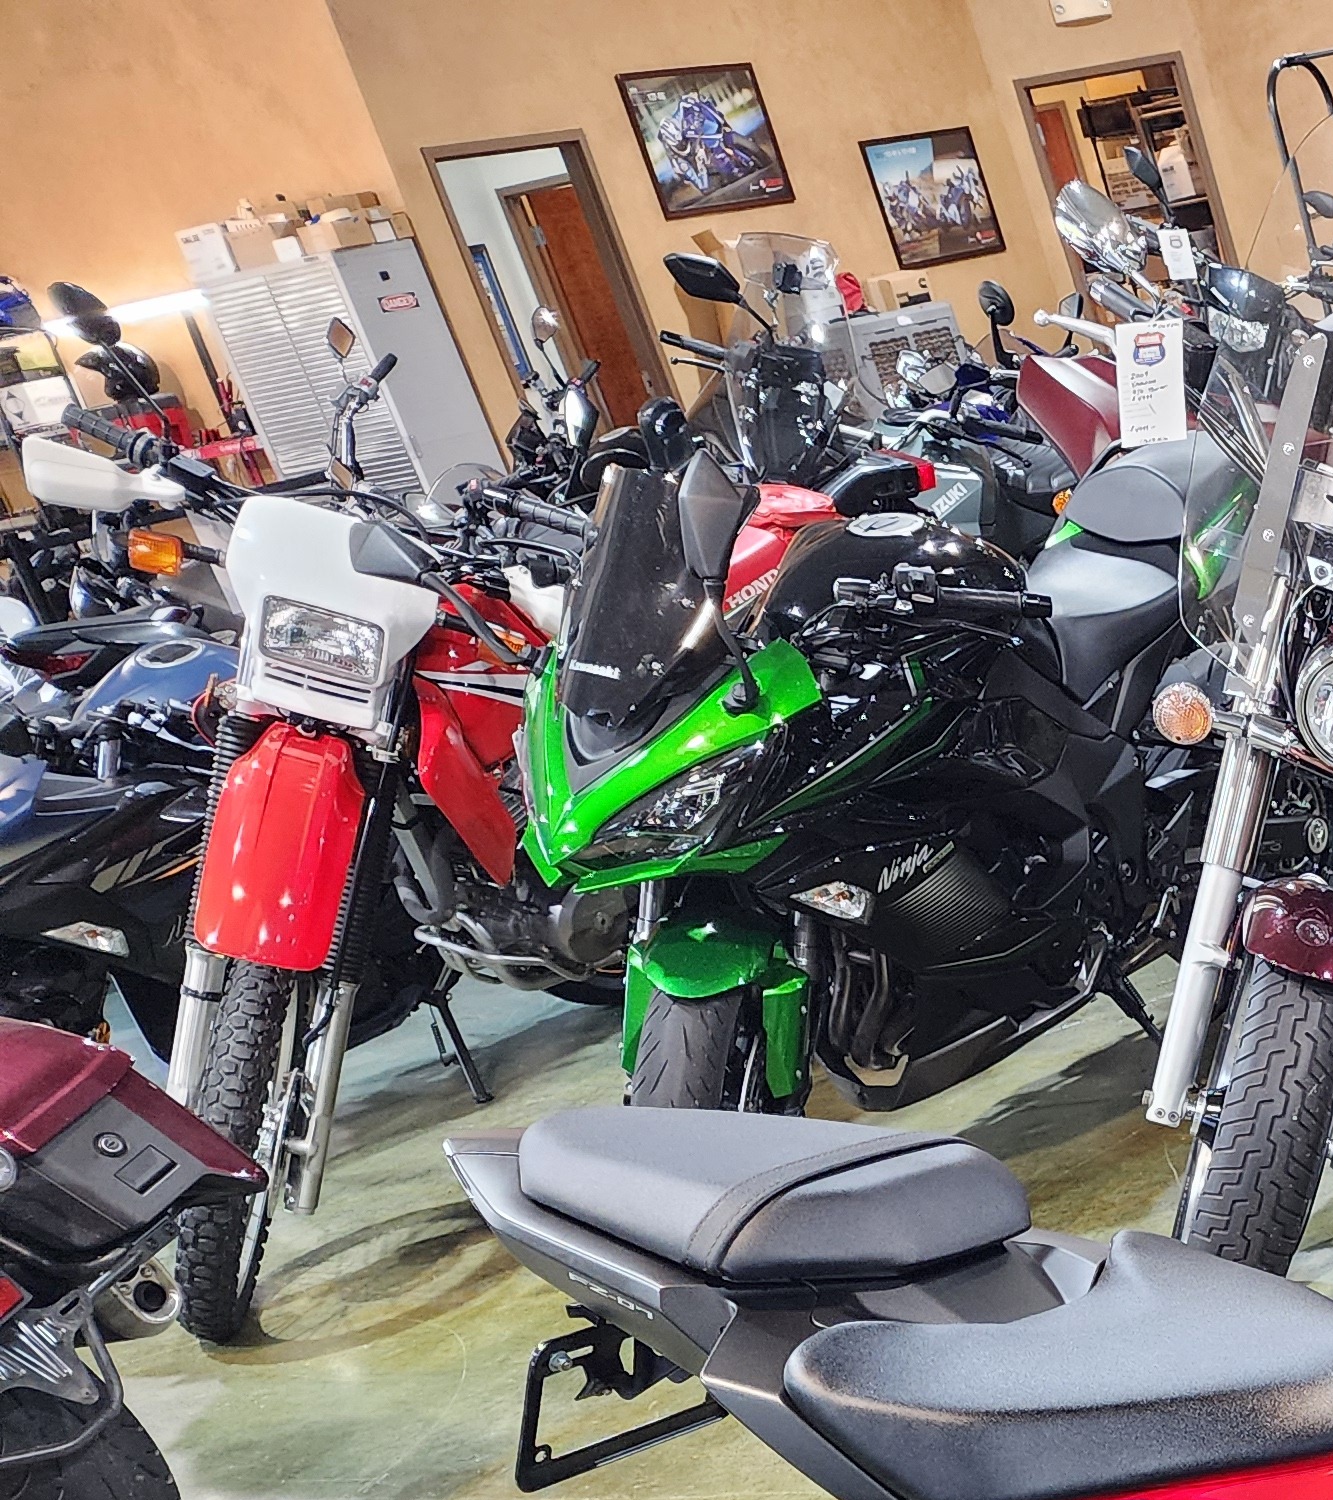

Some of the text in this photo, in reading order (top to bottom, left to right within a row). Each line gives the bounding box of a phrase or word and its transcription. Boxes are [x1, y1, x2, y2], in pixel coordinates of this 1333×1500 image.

[932, 481, 968, 520] ZUKI
[726, 567, 782, 609] HOND
[569, 659, 621, 680] Kawasaki
[877, 843, 935, 894] Ninja
[568, 1271, 654, 1320] FZ-07
